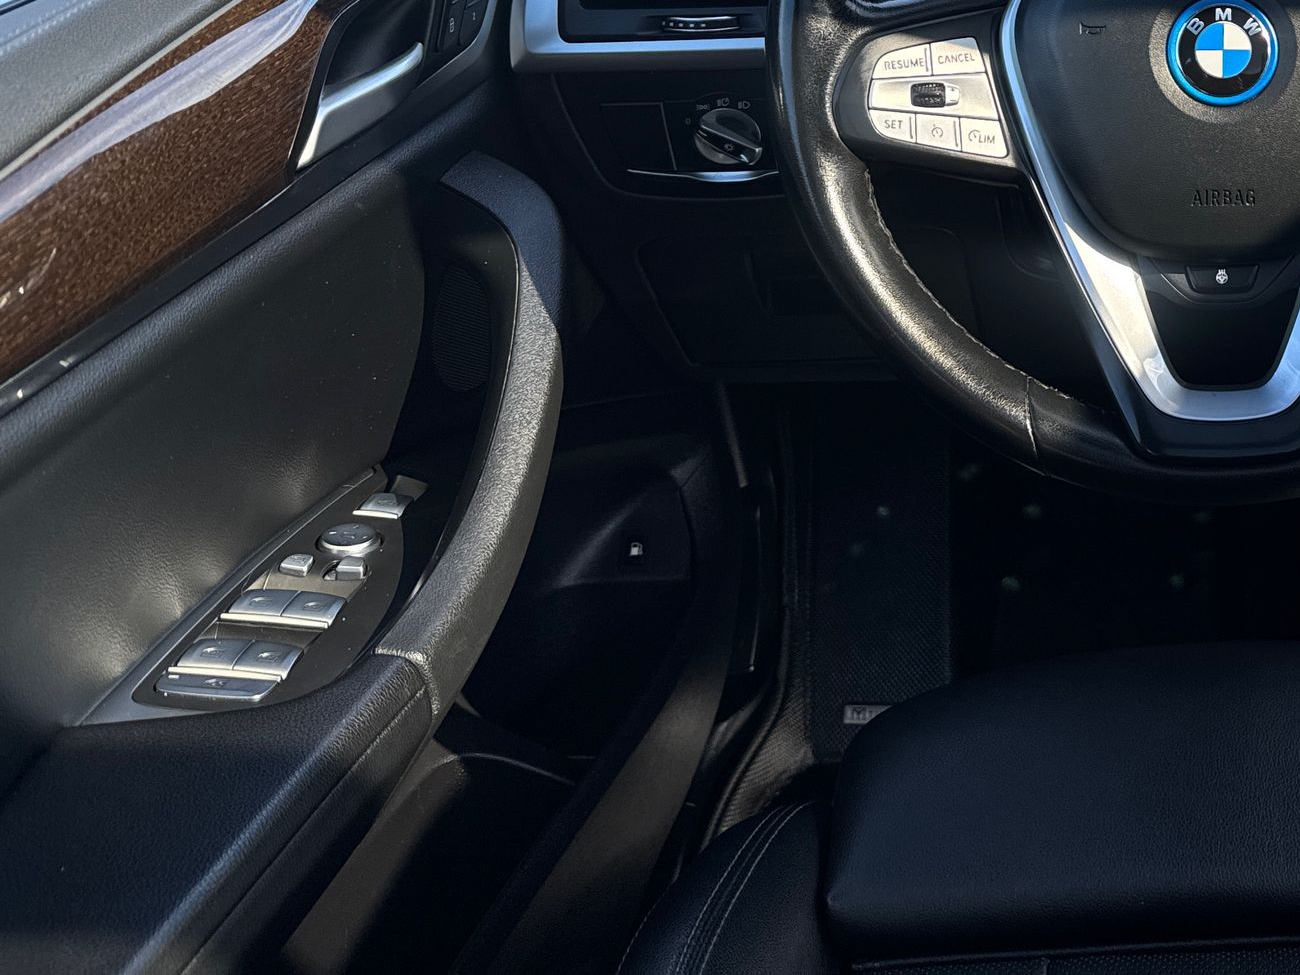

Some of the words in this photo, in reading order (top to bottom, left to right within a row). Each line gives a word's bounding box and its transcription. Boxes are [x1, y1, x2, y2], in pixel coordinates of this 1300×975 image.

[1186, 7, 1262, 37] BMW
[884, 57, 925, 71] RESUME
[937, 52, 975, 65] CANCEL
[884, 119, 904, 130] SET
[978, 133, 996, 144] LIM
[1191, 189, 1256, 207] AIRBAG
